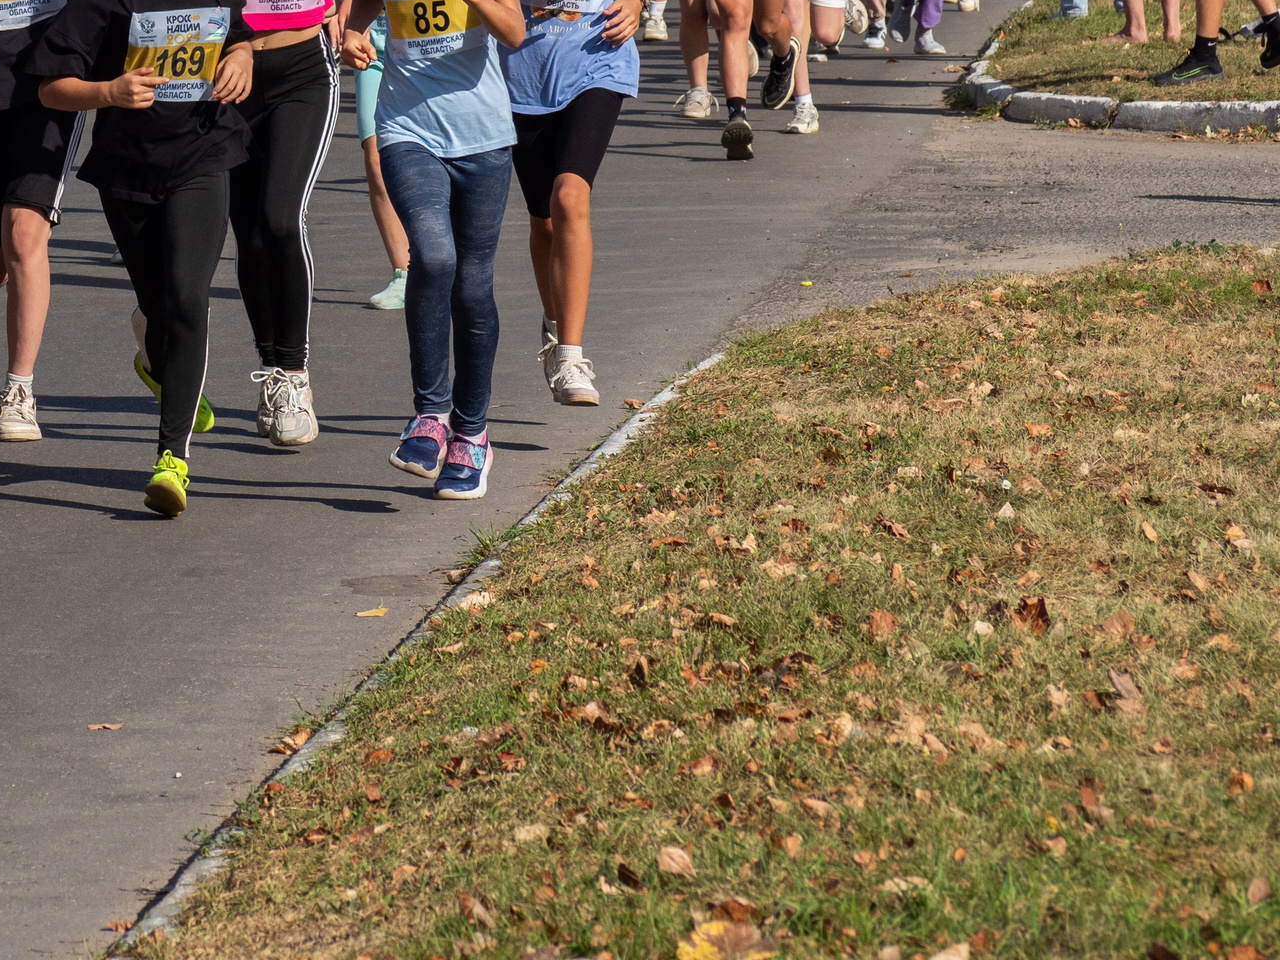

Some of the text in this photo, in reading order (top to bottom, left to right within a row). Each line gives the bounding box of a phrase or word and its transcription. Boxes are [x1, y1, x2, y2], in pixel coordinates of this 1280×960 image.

[9, 6, 40, 16] ОБЛАСТЬ
[546, 1, 580, 10] ОБЛАСТЬ
[166, 14, 192, 24] КРОСС
[413, 0, 450, 35] 85
[166, 23, 201, 34] НАЦИИ
[166, 32, 201, 45] 2024
[407, 33, 465, 49] ВЛАДИМИРСКАЯ
[420, 44, 455, 56] ОБЛАСТЬ
[155, 45, 205, 77] 169
[155, 82, 205, 91] АДИМИРСКАЯ
[157, 91, 192, 99] ОБЛАСТЬ
